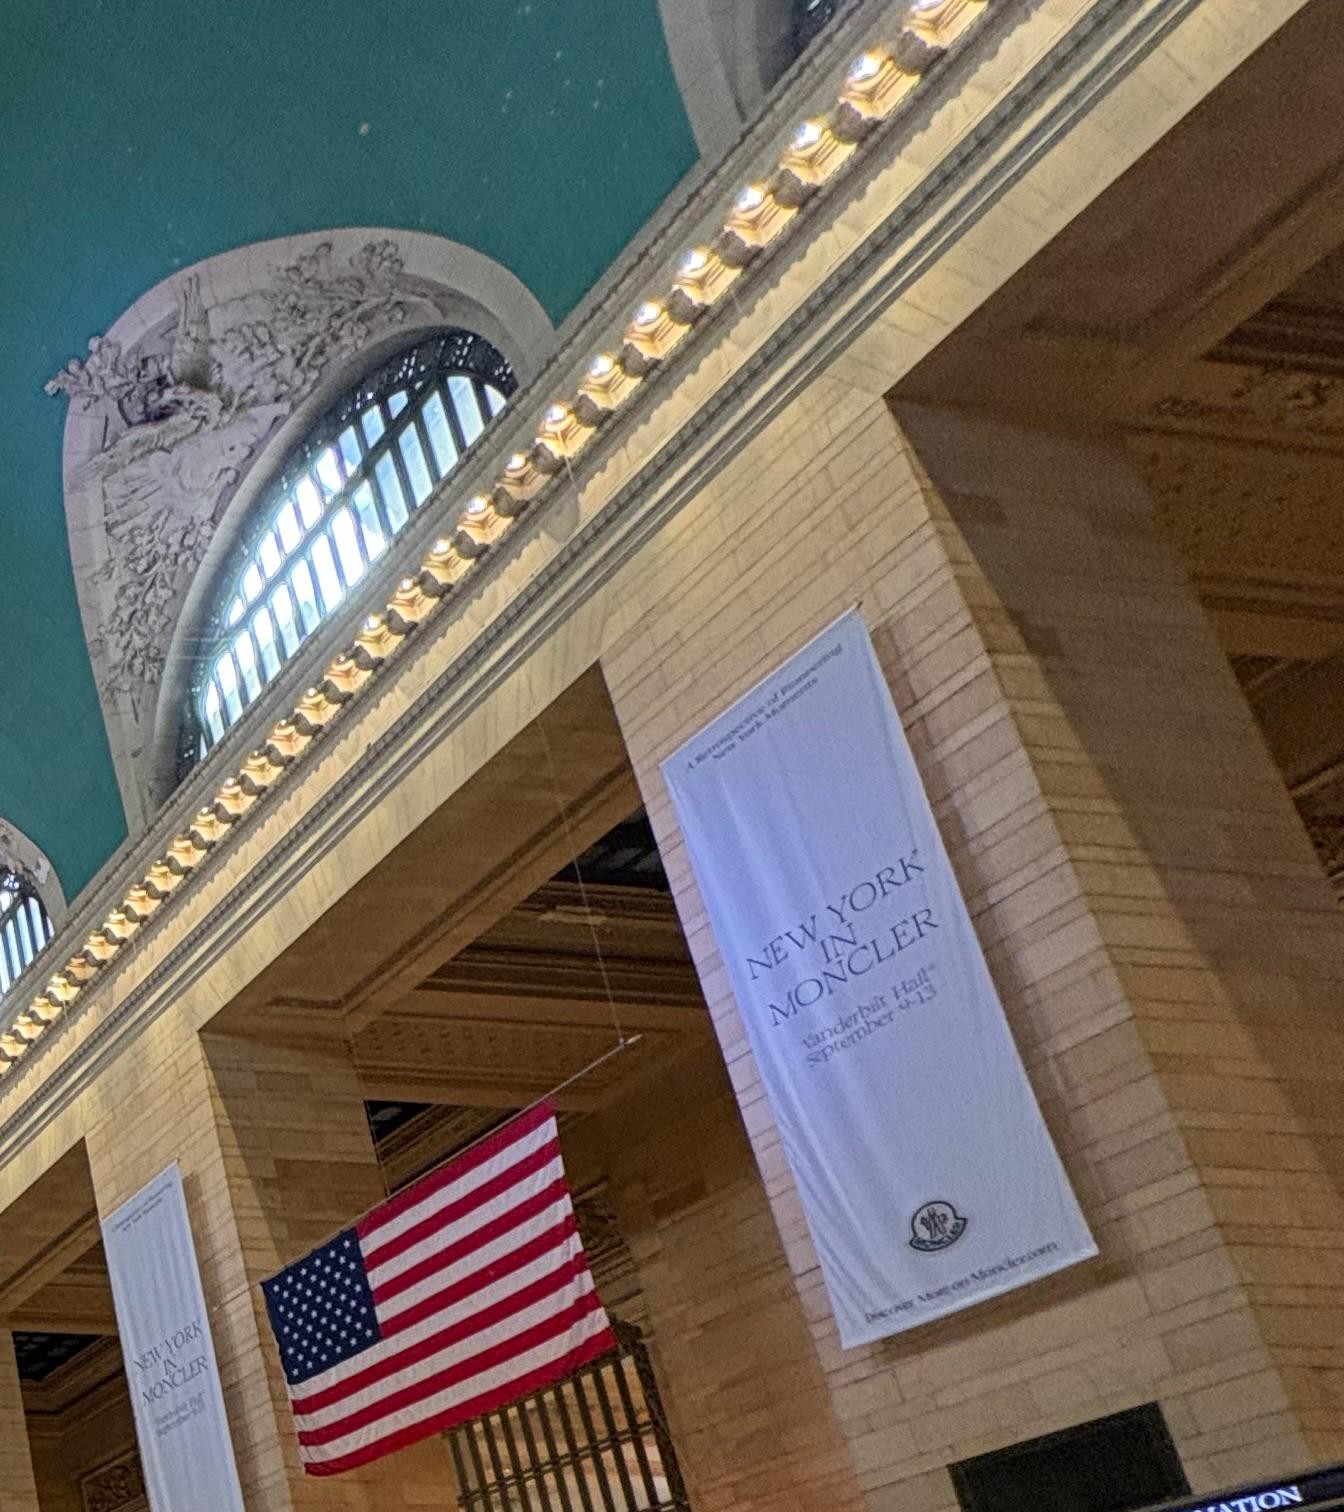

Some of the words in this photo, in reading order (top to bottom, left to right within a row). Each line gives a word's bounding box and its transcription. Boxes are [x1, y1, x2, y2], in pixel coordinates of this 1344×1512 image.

[746, 914, 817, 981] NEW
[825, 848, 925, 924] YORK
[768, 907, 940, 1027] MONCLER
[819, 922, 858, 965] IN
[164, 1319, 203, 1357] YORK
[142, 1355, 209, 1408] MONCLER
